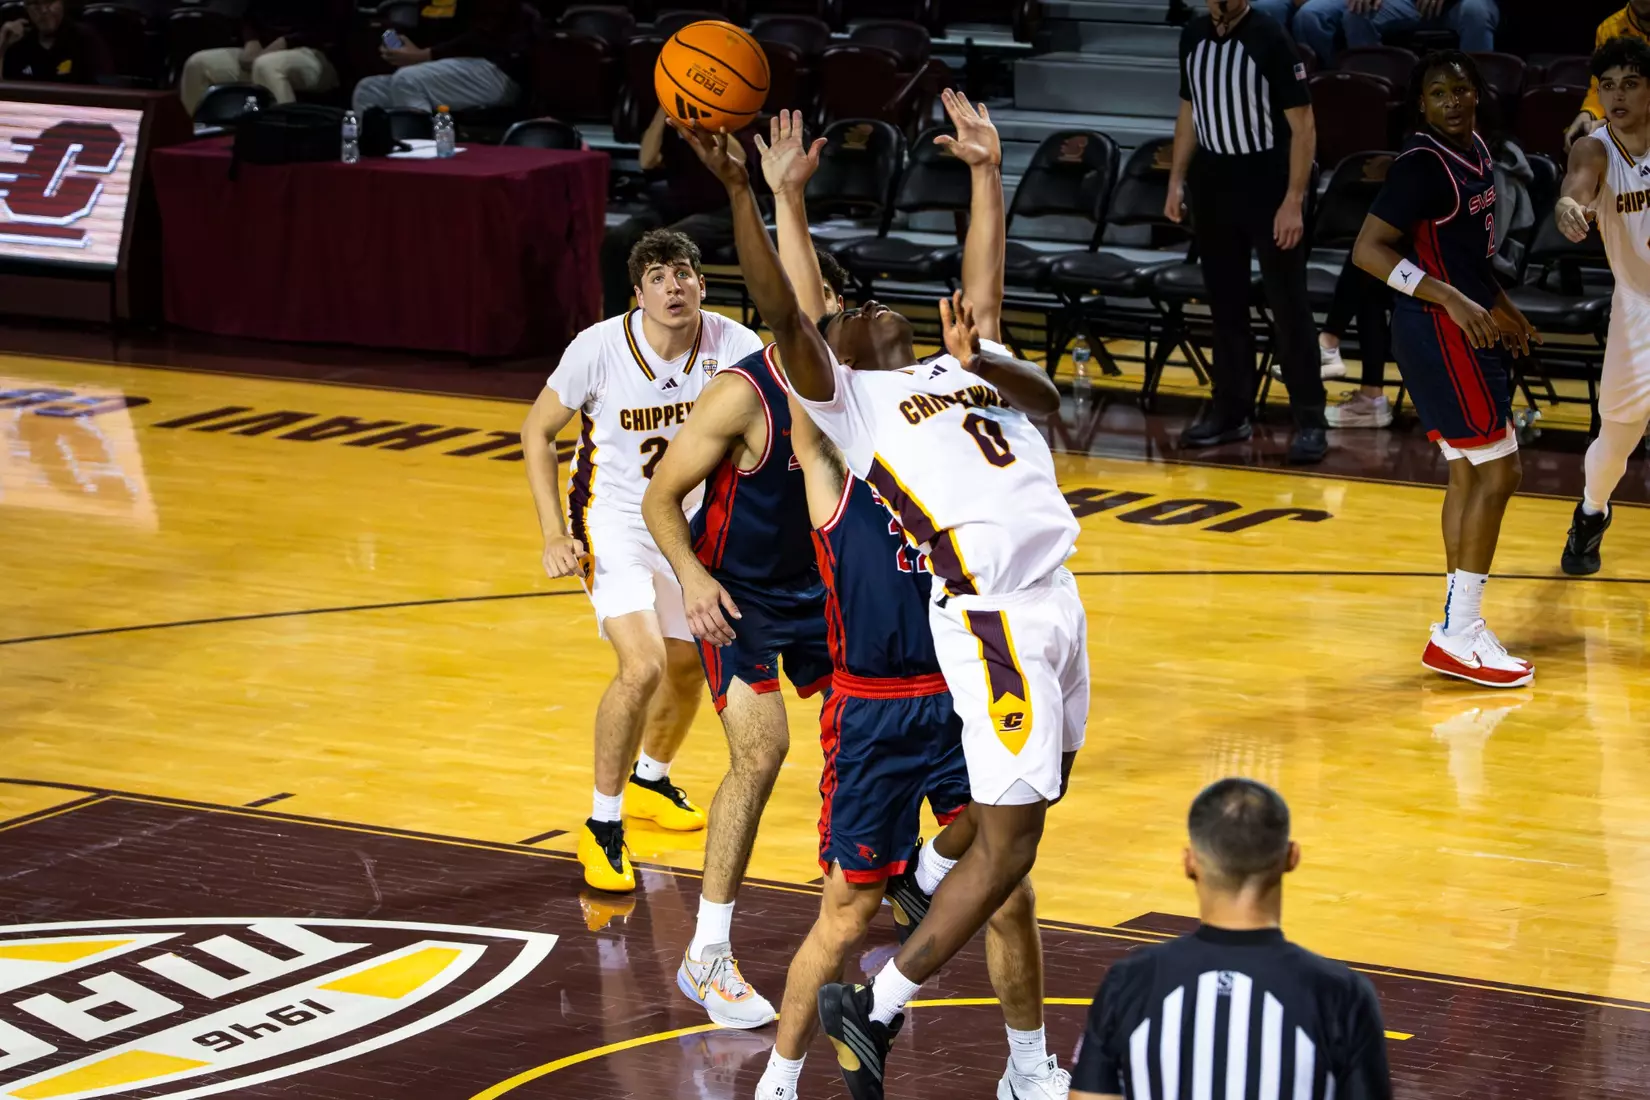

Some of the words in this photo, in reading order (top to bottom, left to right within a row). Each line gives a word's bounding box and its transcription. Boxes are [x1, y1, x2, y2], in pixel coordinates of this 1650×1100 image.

[692, 72, 727, 97] PRO
[962, 412, 1017, 468] 0
[1056, 487, 1334, 533] JOH
[888, 517, 930, 573] 2
[192, 998, 336, 1053] 1946
